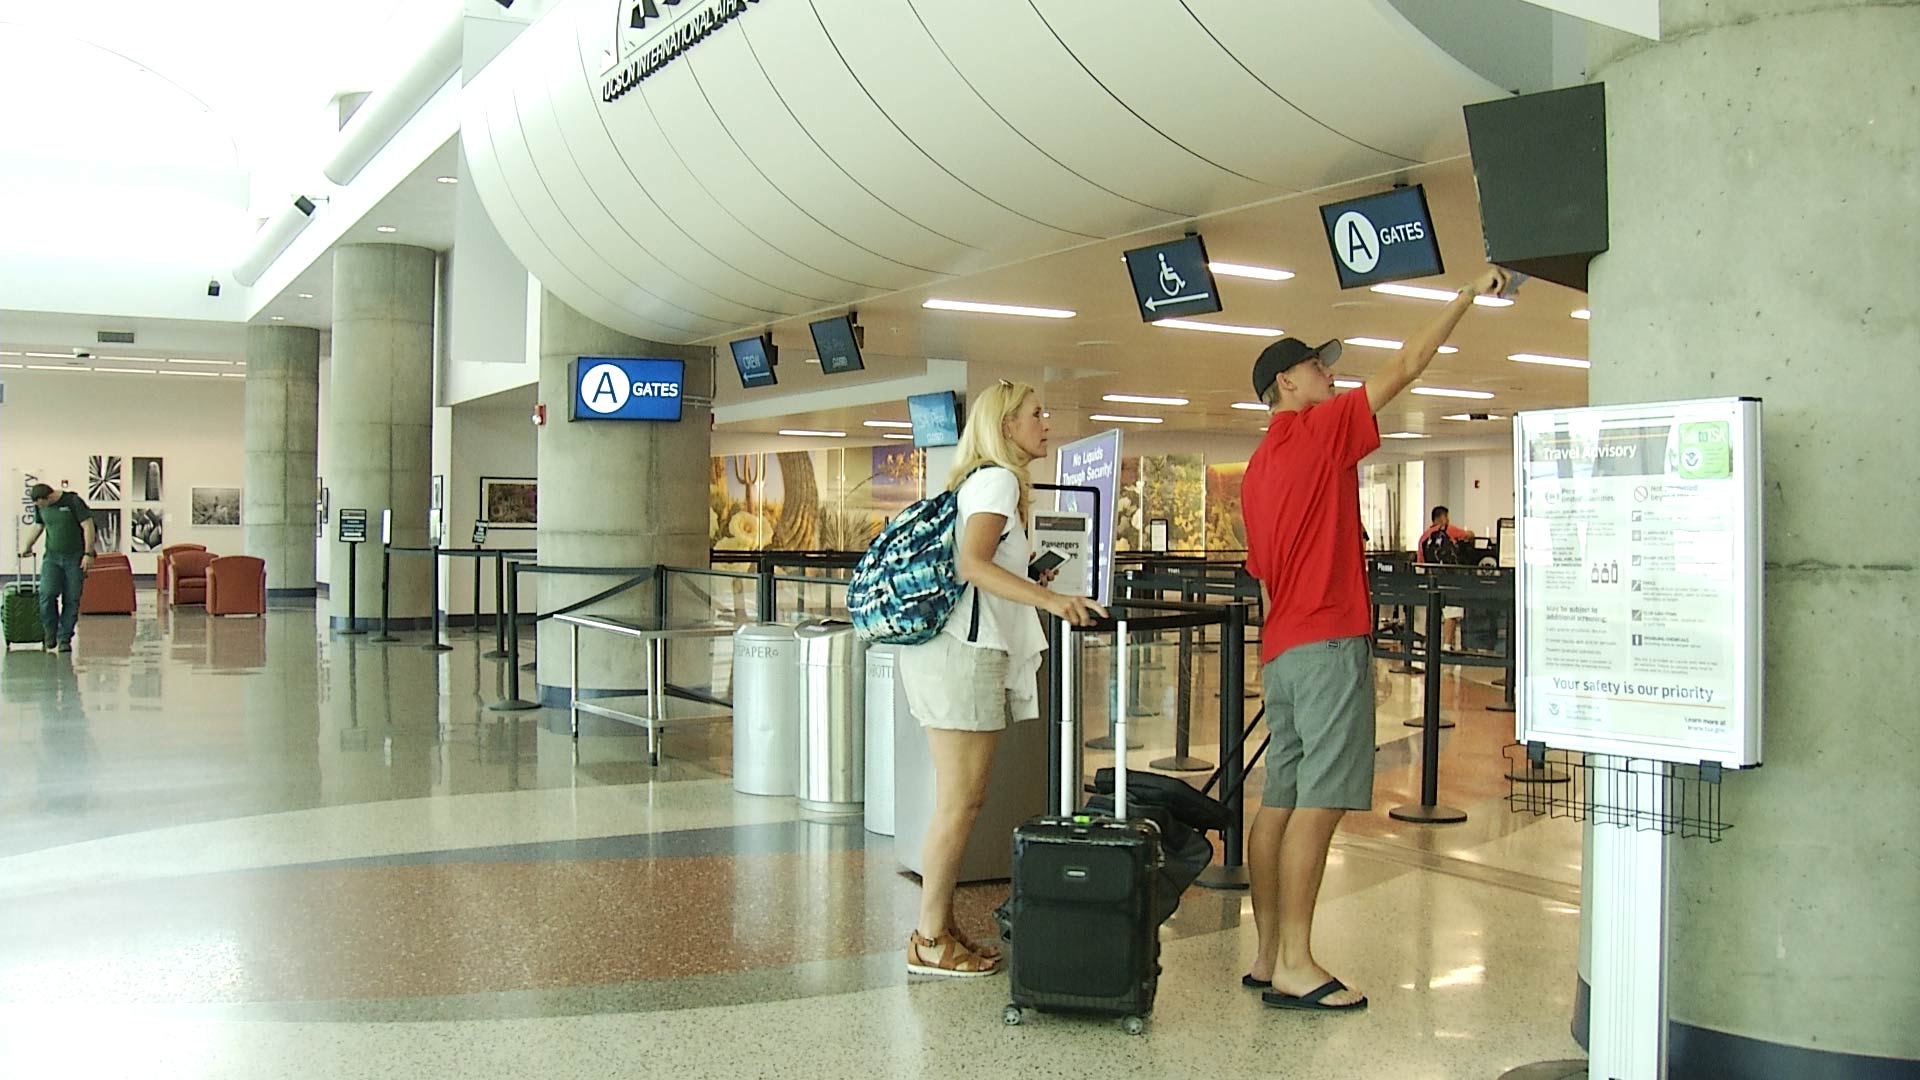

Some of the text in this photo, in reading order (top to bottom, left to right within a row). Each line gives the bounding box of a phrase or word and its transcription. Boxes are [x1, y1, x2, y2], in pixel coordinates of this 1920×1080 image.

[636, 8, 714, 80] INTERNATIONAL
[1348, 220, 1424, 263] A GATES
[592, 371, 679, 403] A GATES
[1073, 446, 1104, 467] No Liquids
[1544, 443, 1637, 460] Travel Advisory
[1063, 470, 1086, 486] Through
[22, 473, 39, 525] Gallery
[1041, 540, 1079, 550] Passengers
[1553, 677, 1714, 702] Your safety is our priority
